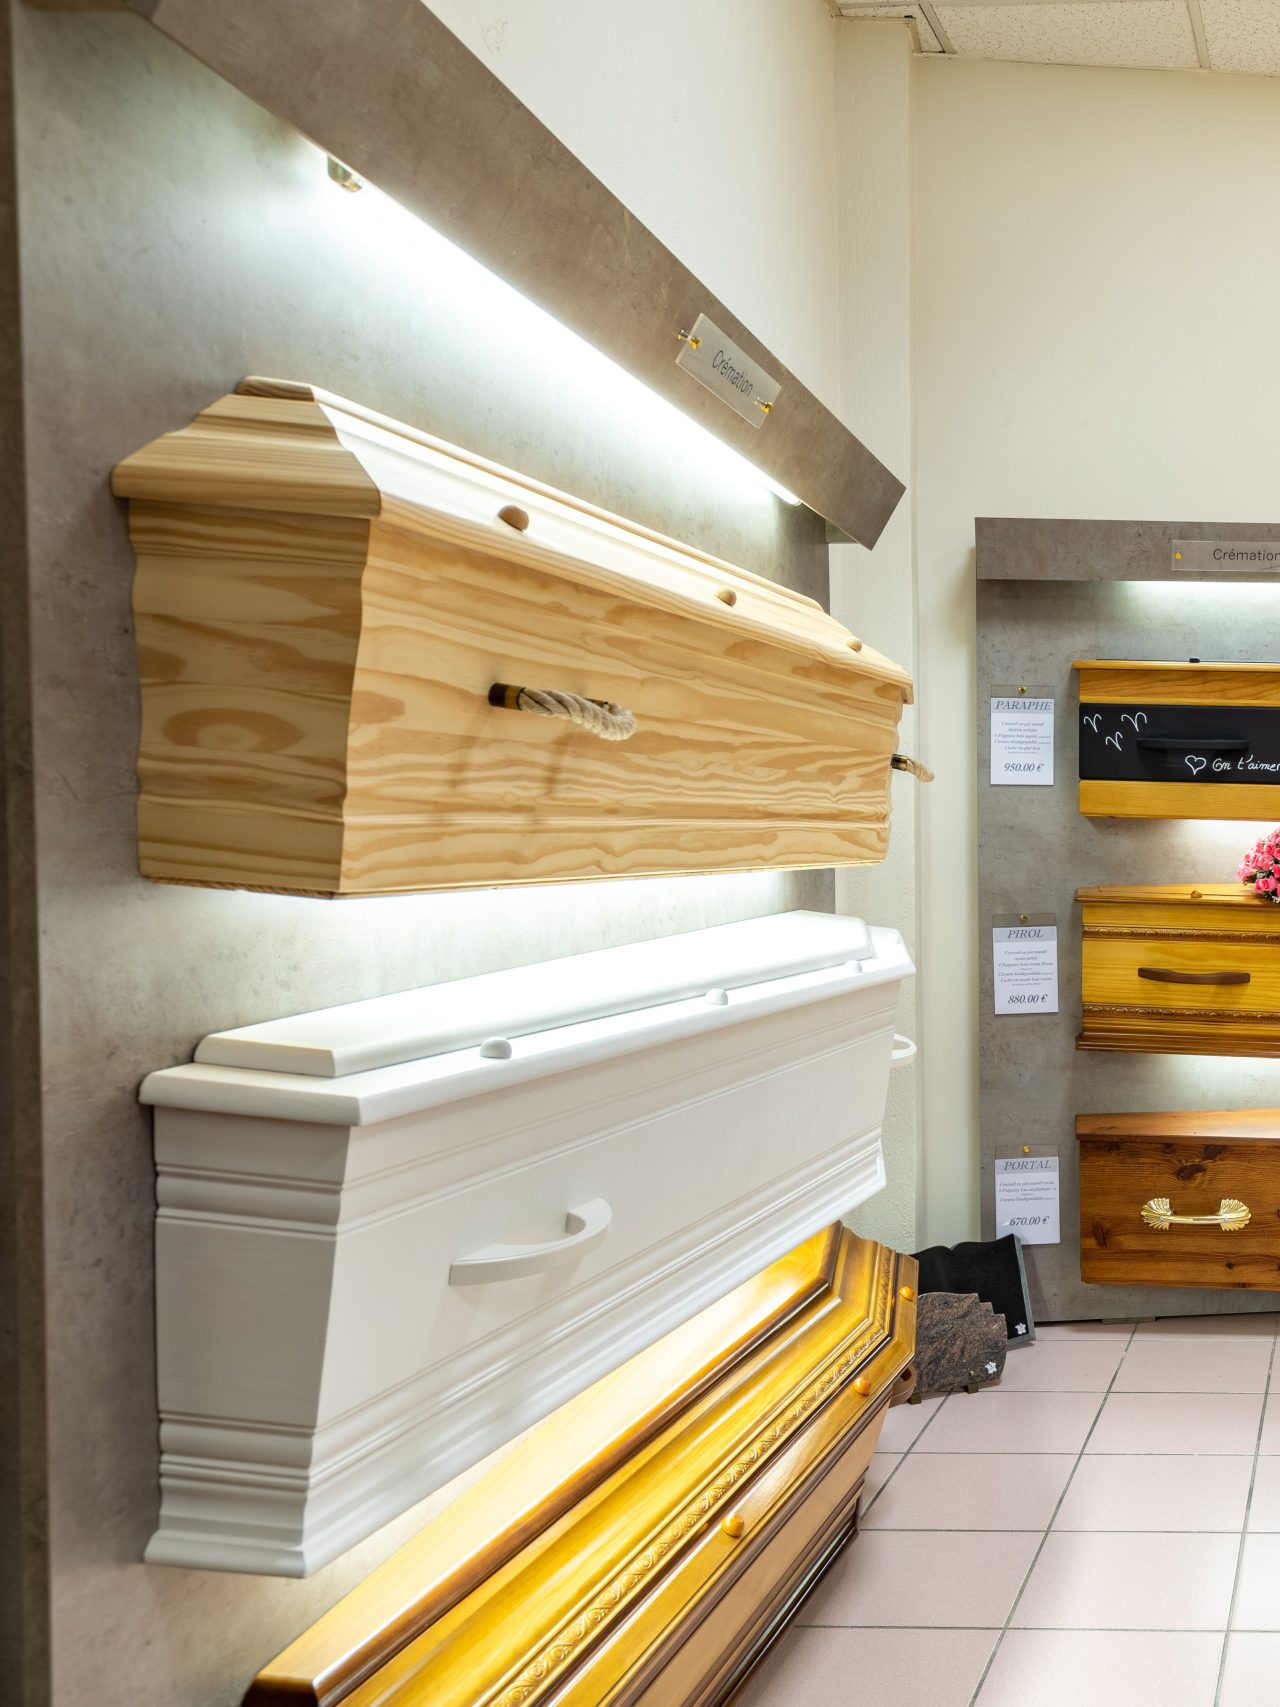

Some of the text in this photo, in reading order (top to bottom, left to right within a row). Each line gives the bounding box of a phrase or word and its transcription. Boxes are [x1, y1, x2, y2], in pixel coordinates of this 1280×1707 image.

[711, 349, 754, 397] Crémation
[995, 700, 1053, 711] PARAPHE
[1004, 763, 1044, 772] 950.00 €
[1007, 929, 1044, 939] PIROL
[1008, 994, 1048, 1004] 880.00 €
[1003, 1160, 1052, 1171] PORTAL
[1009, 1216, 1050, 1226] 670.00 €
